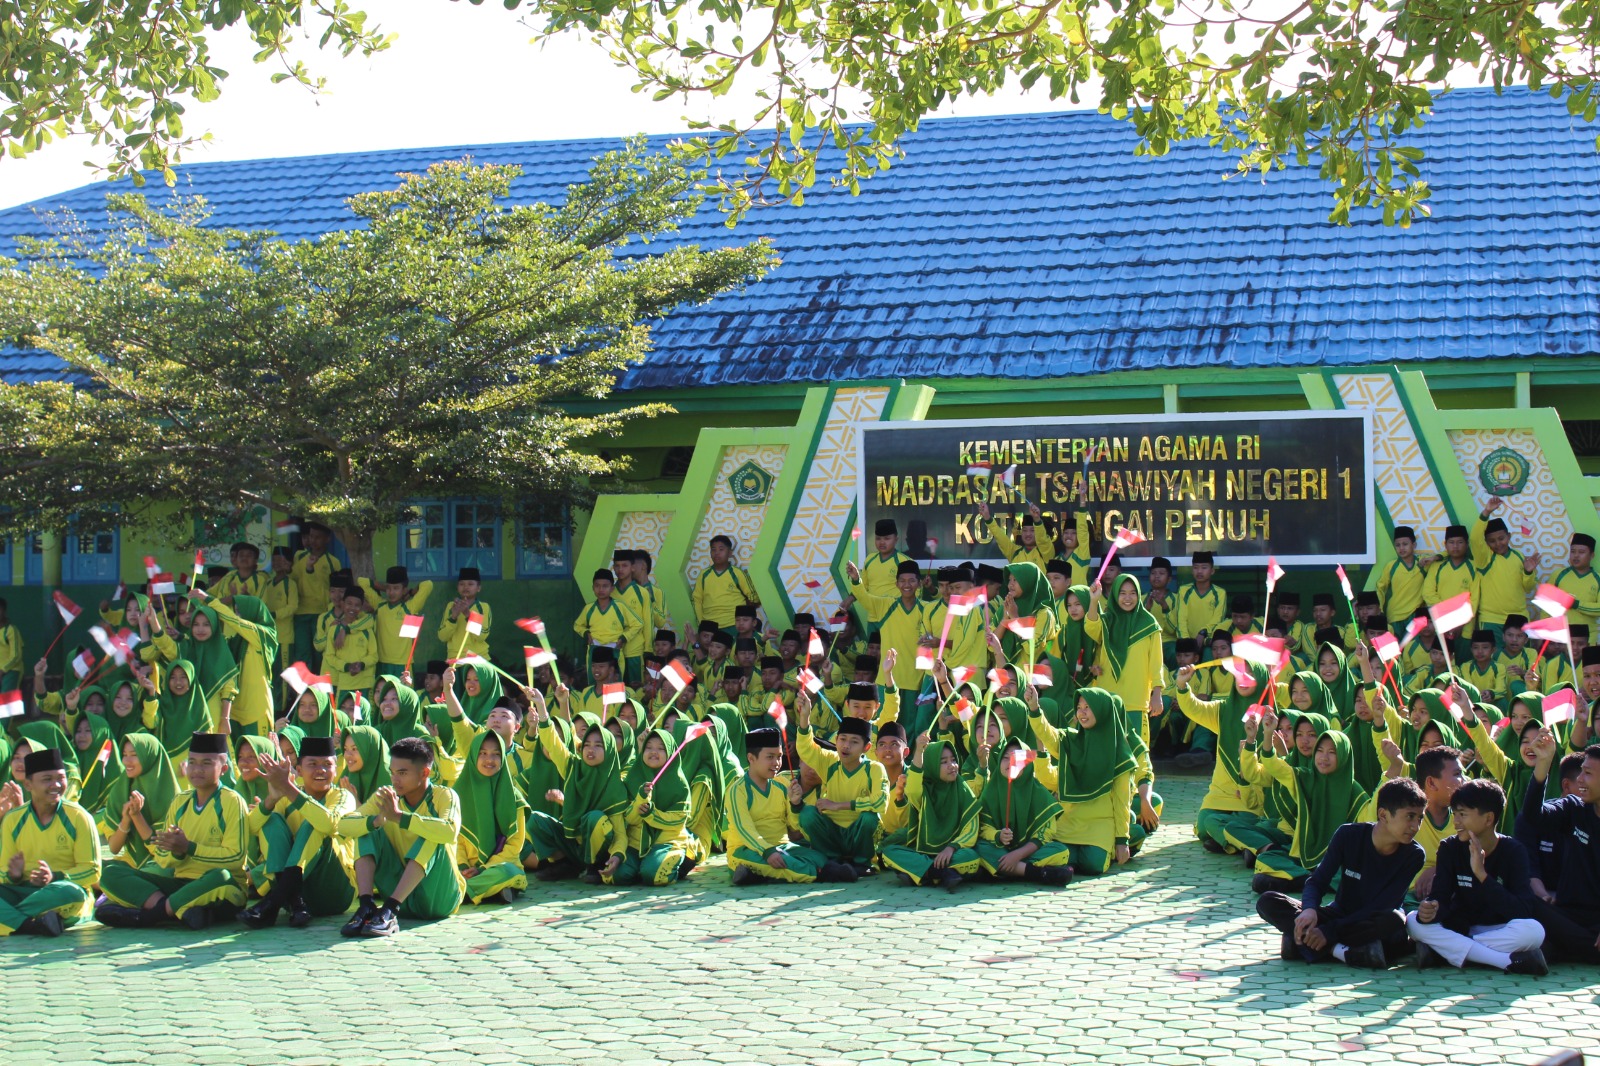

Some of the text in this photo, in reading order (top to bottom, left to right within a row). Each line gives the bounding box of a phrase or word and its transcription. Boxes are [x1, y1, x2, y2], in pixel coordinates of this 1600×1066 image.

[959, 434, 1260, 466] KEMENTERIAN AGAMA RI
[876, 467, 1351, 506] MADRASAH TSANAWIYAH NEGERI 1
[1166, 509, 1270, 542] PENUH
